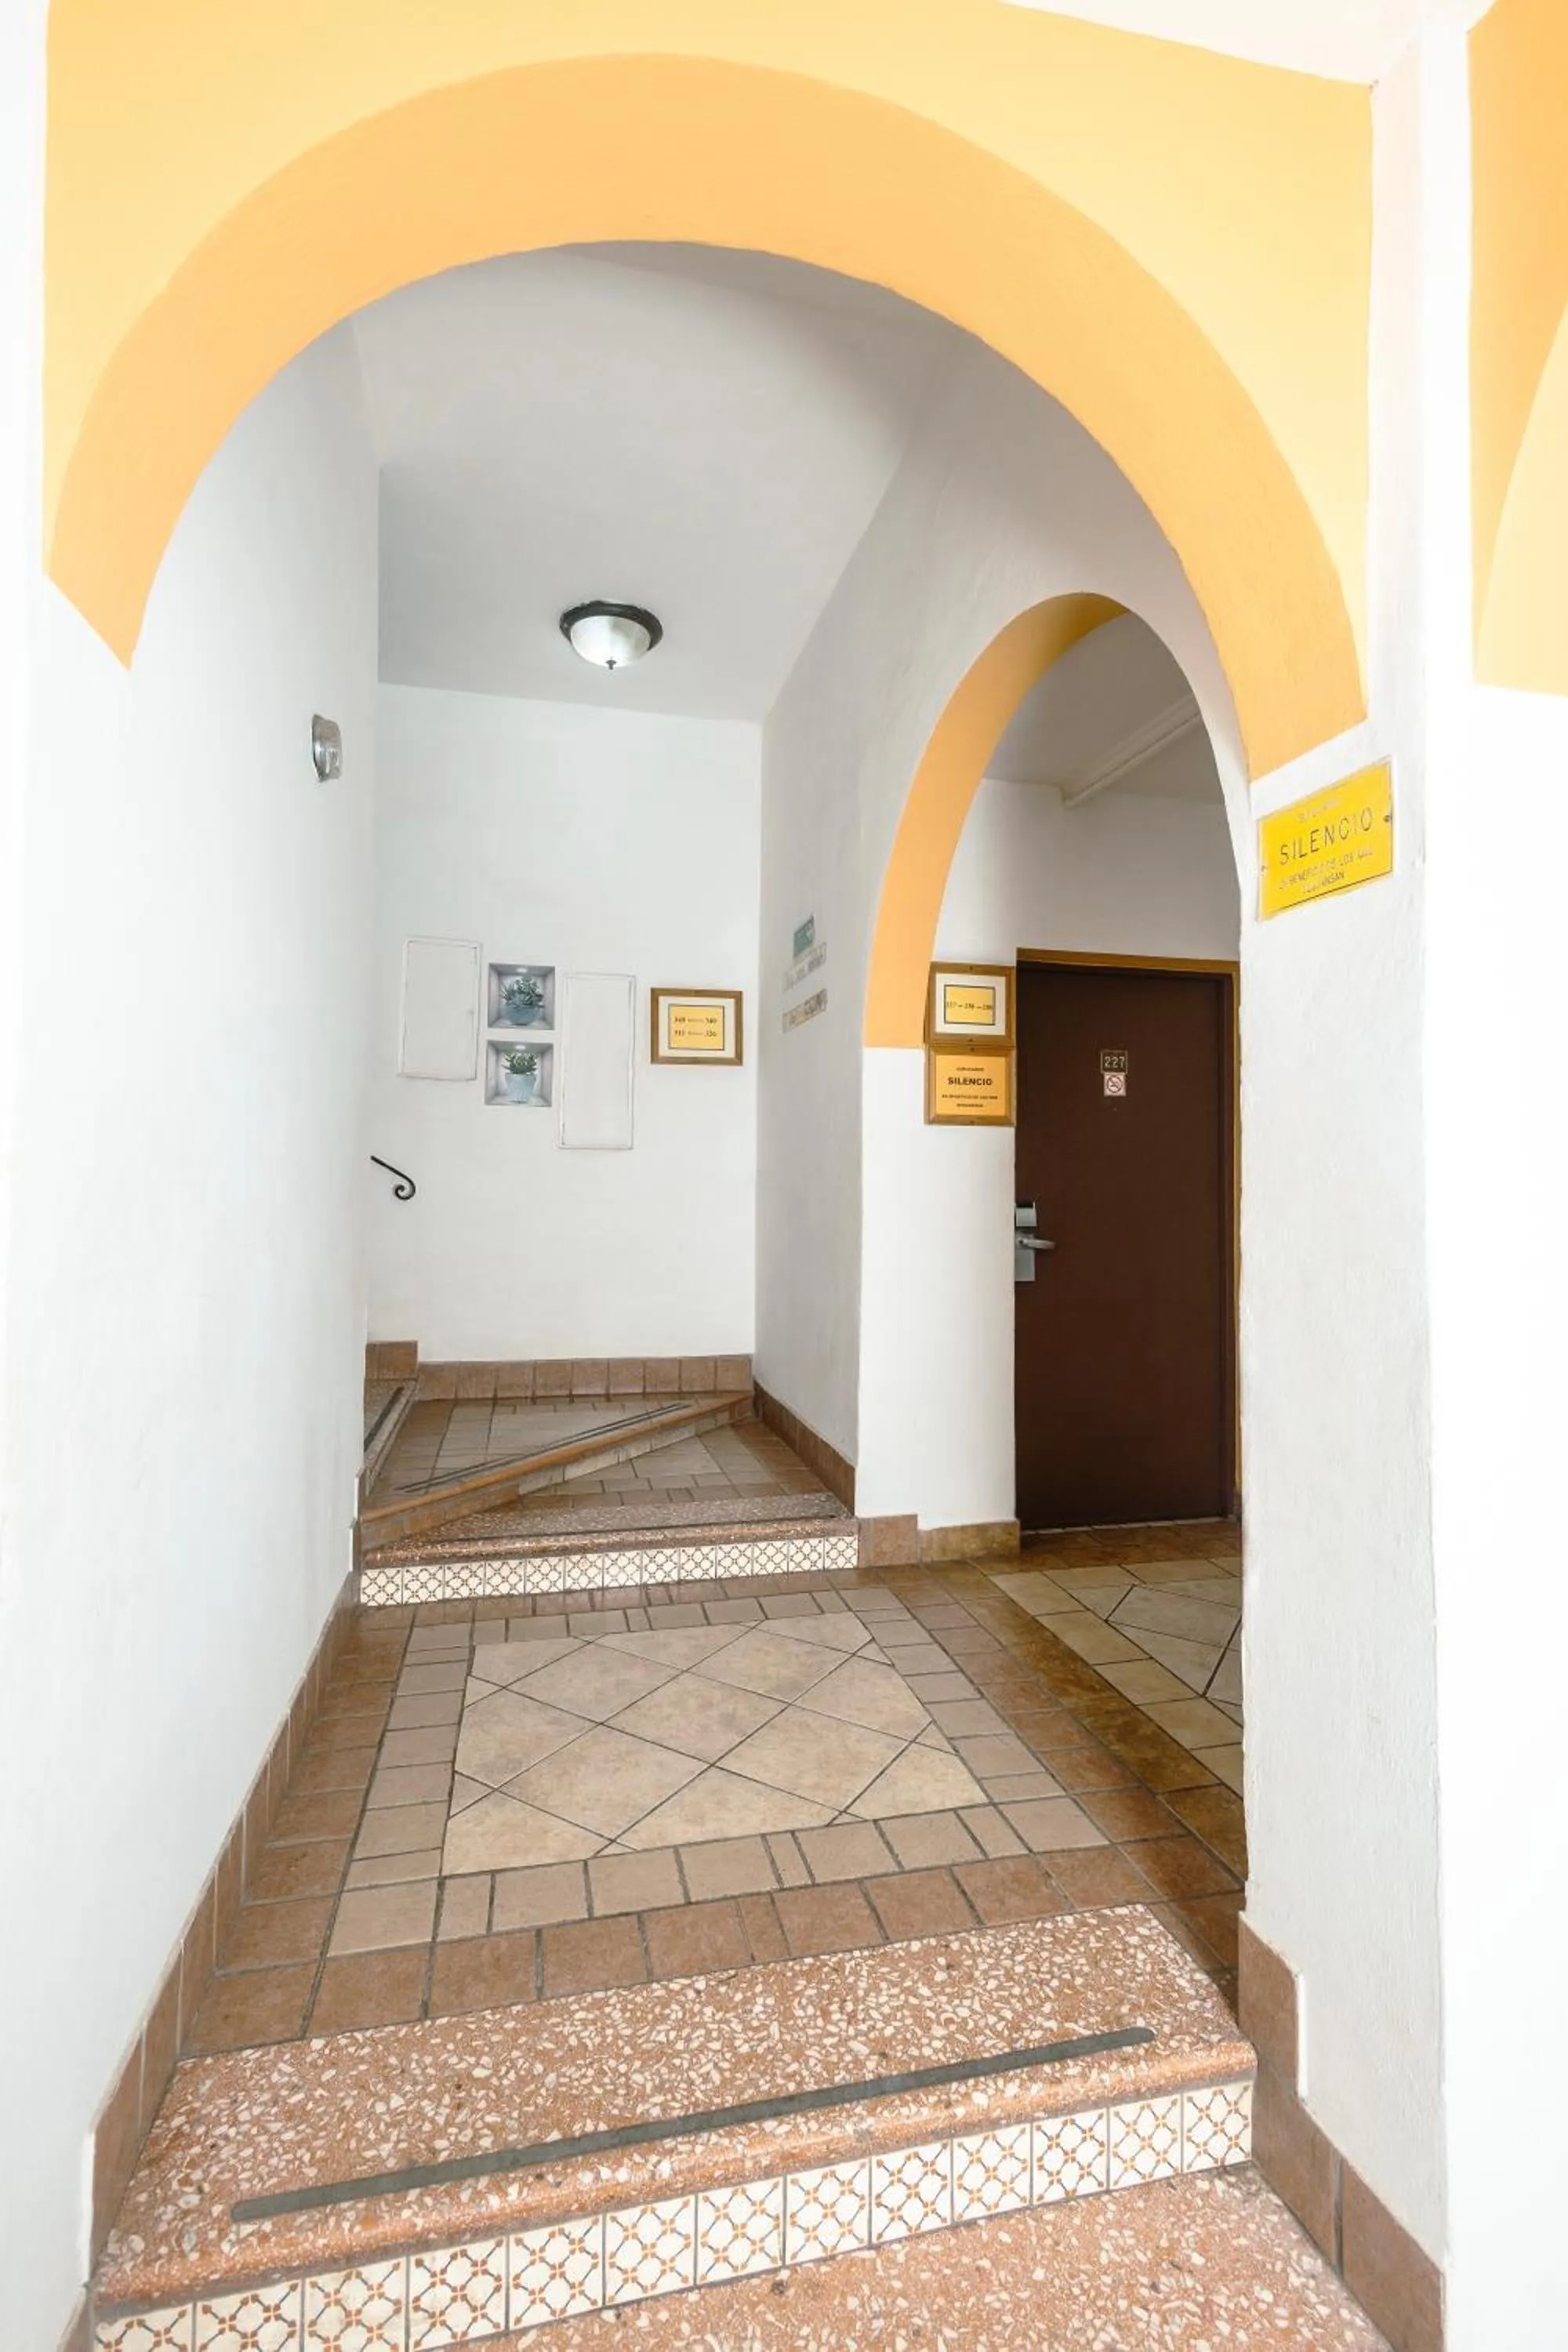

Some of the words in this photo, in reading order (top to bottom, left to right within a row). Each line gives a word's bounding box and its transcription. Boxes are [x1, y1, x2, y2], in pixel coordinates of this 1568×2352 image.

[1279, 808, 1372, 866] SILENCIO
[1104, 1056, 1125, 1068] 227
[948, 1076, 993, 1086] SILENCIO
